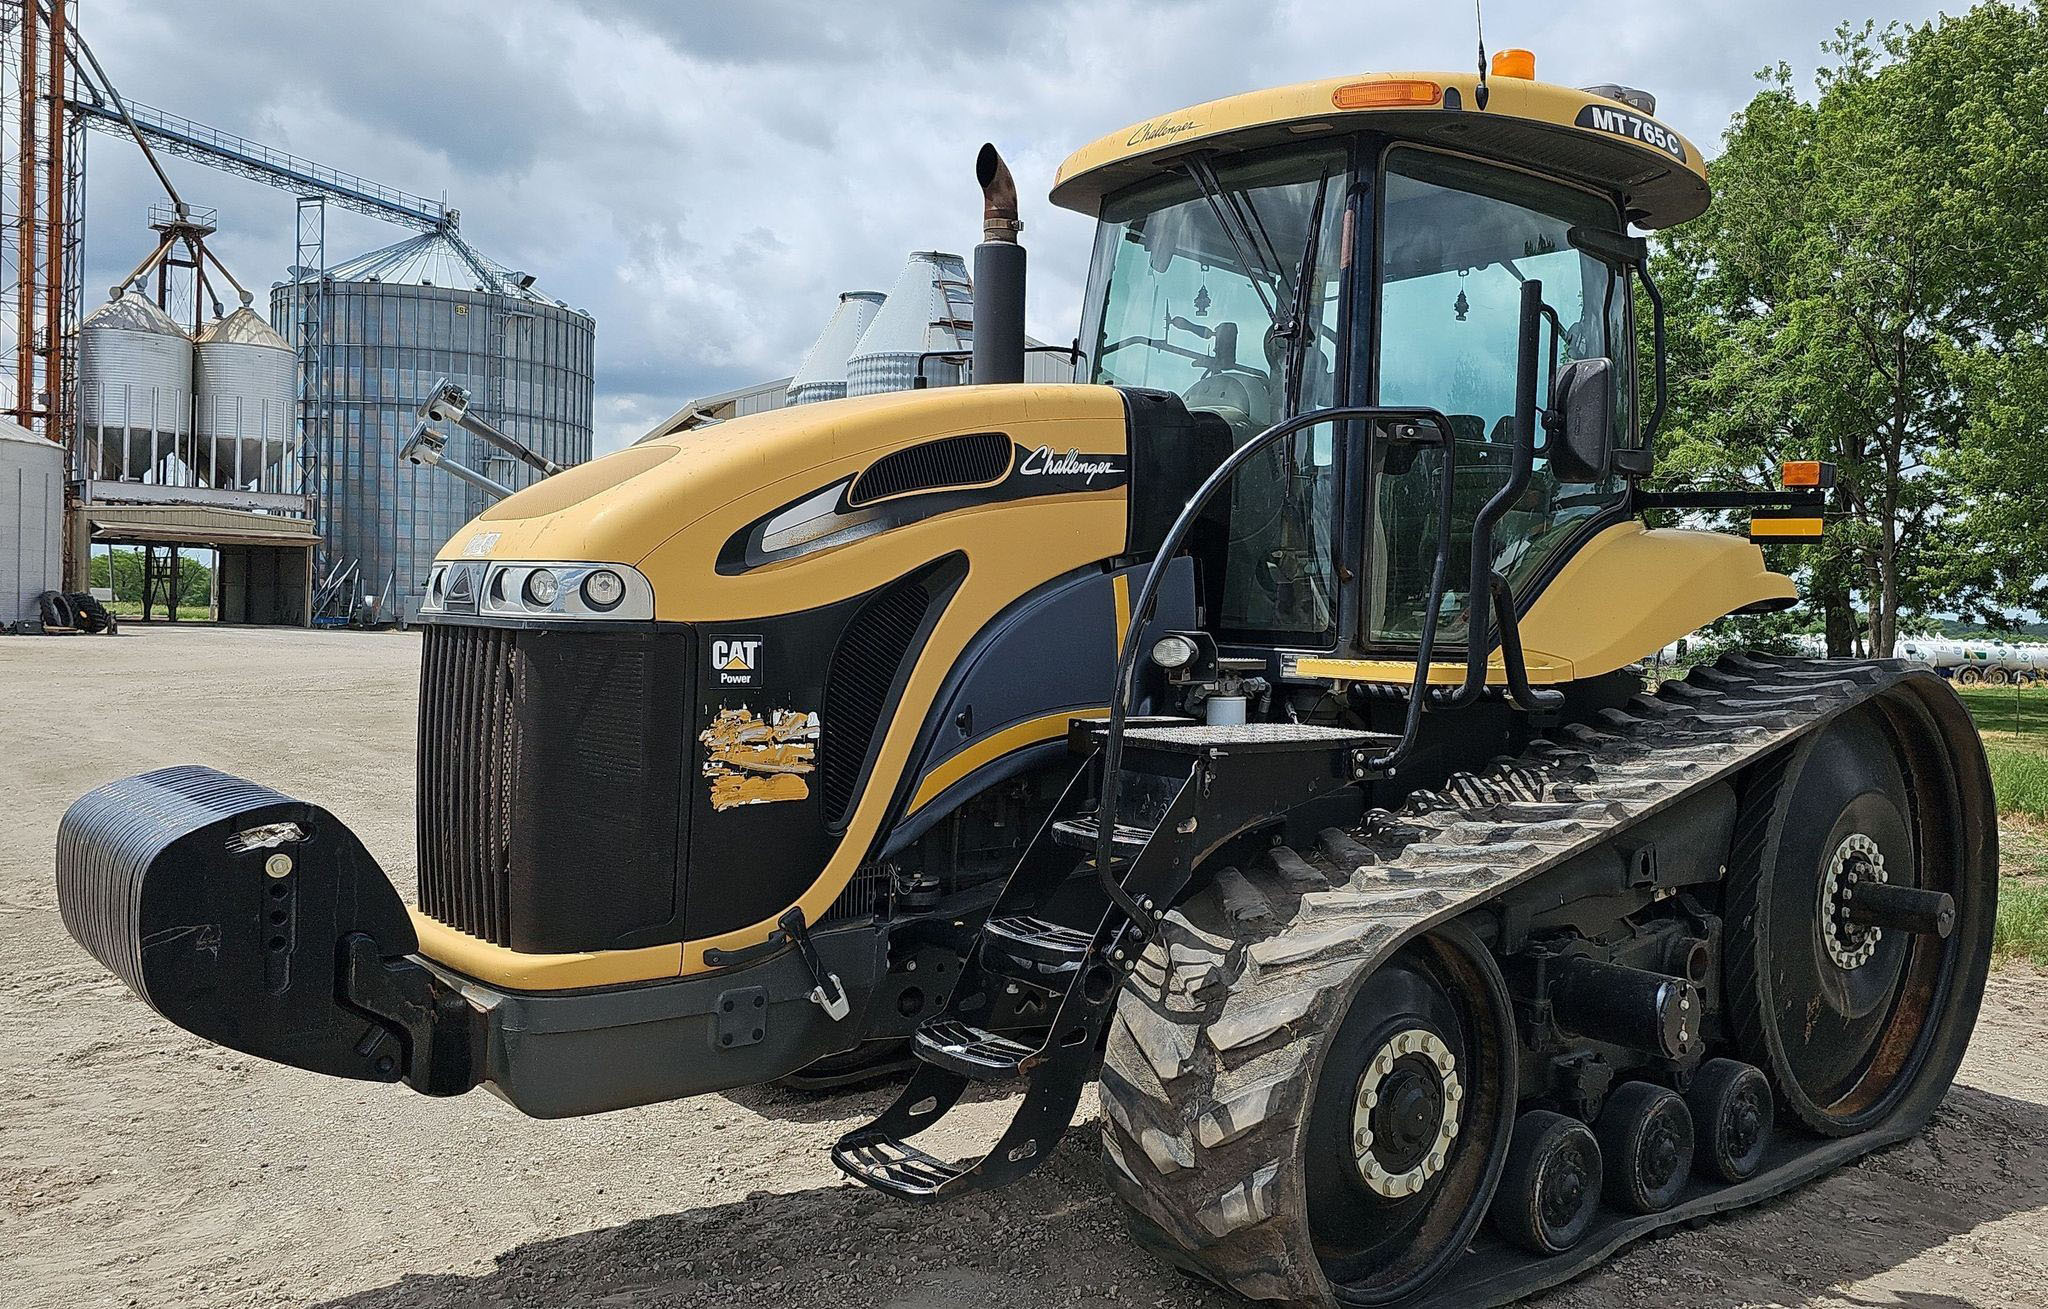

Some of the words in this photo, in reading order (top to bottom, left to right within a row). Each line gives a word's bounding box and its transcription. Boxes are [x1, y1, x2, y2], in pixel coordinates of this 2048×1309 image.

[1127, 118, 1204, 147] Challenger
[1020, 445, 1125, 485] Challenger
[712, 640, 758, 670] CAT
[720, 673, 751, 684] Power
